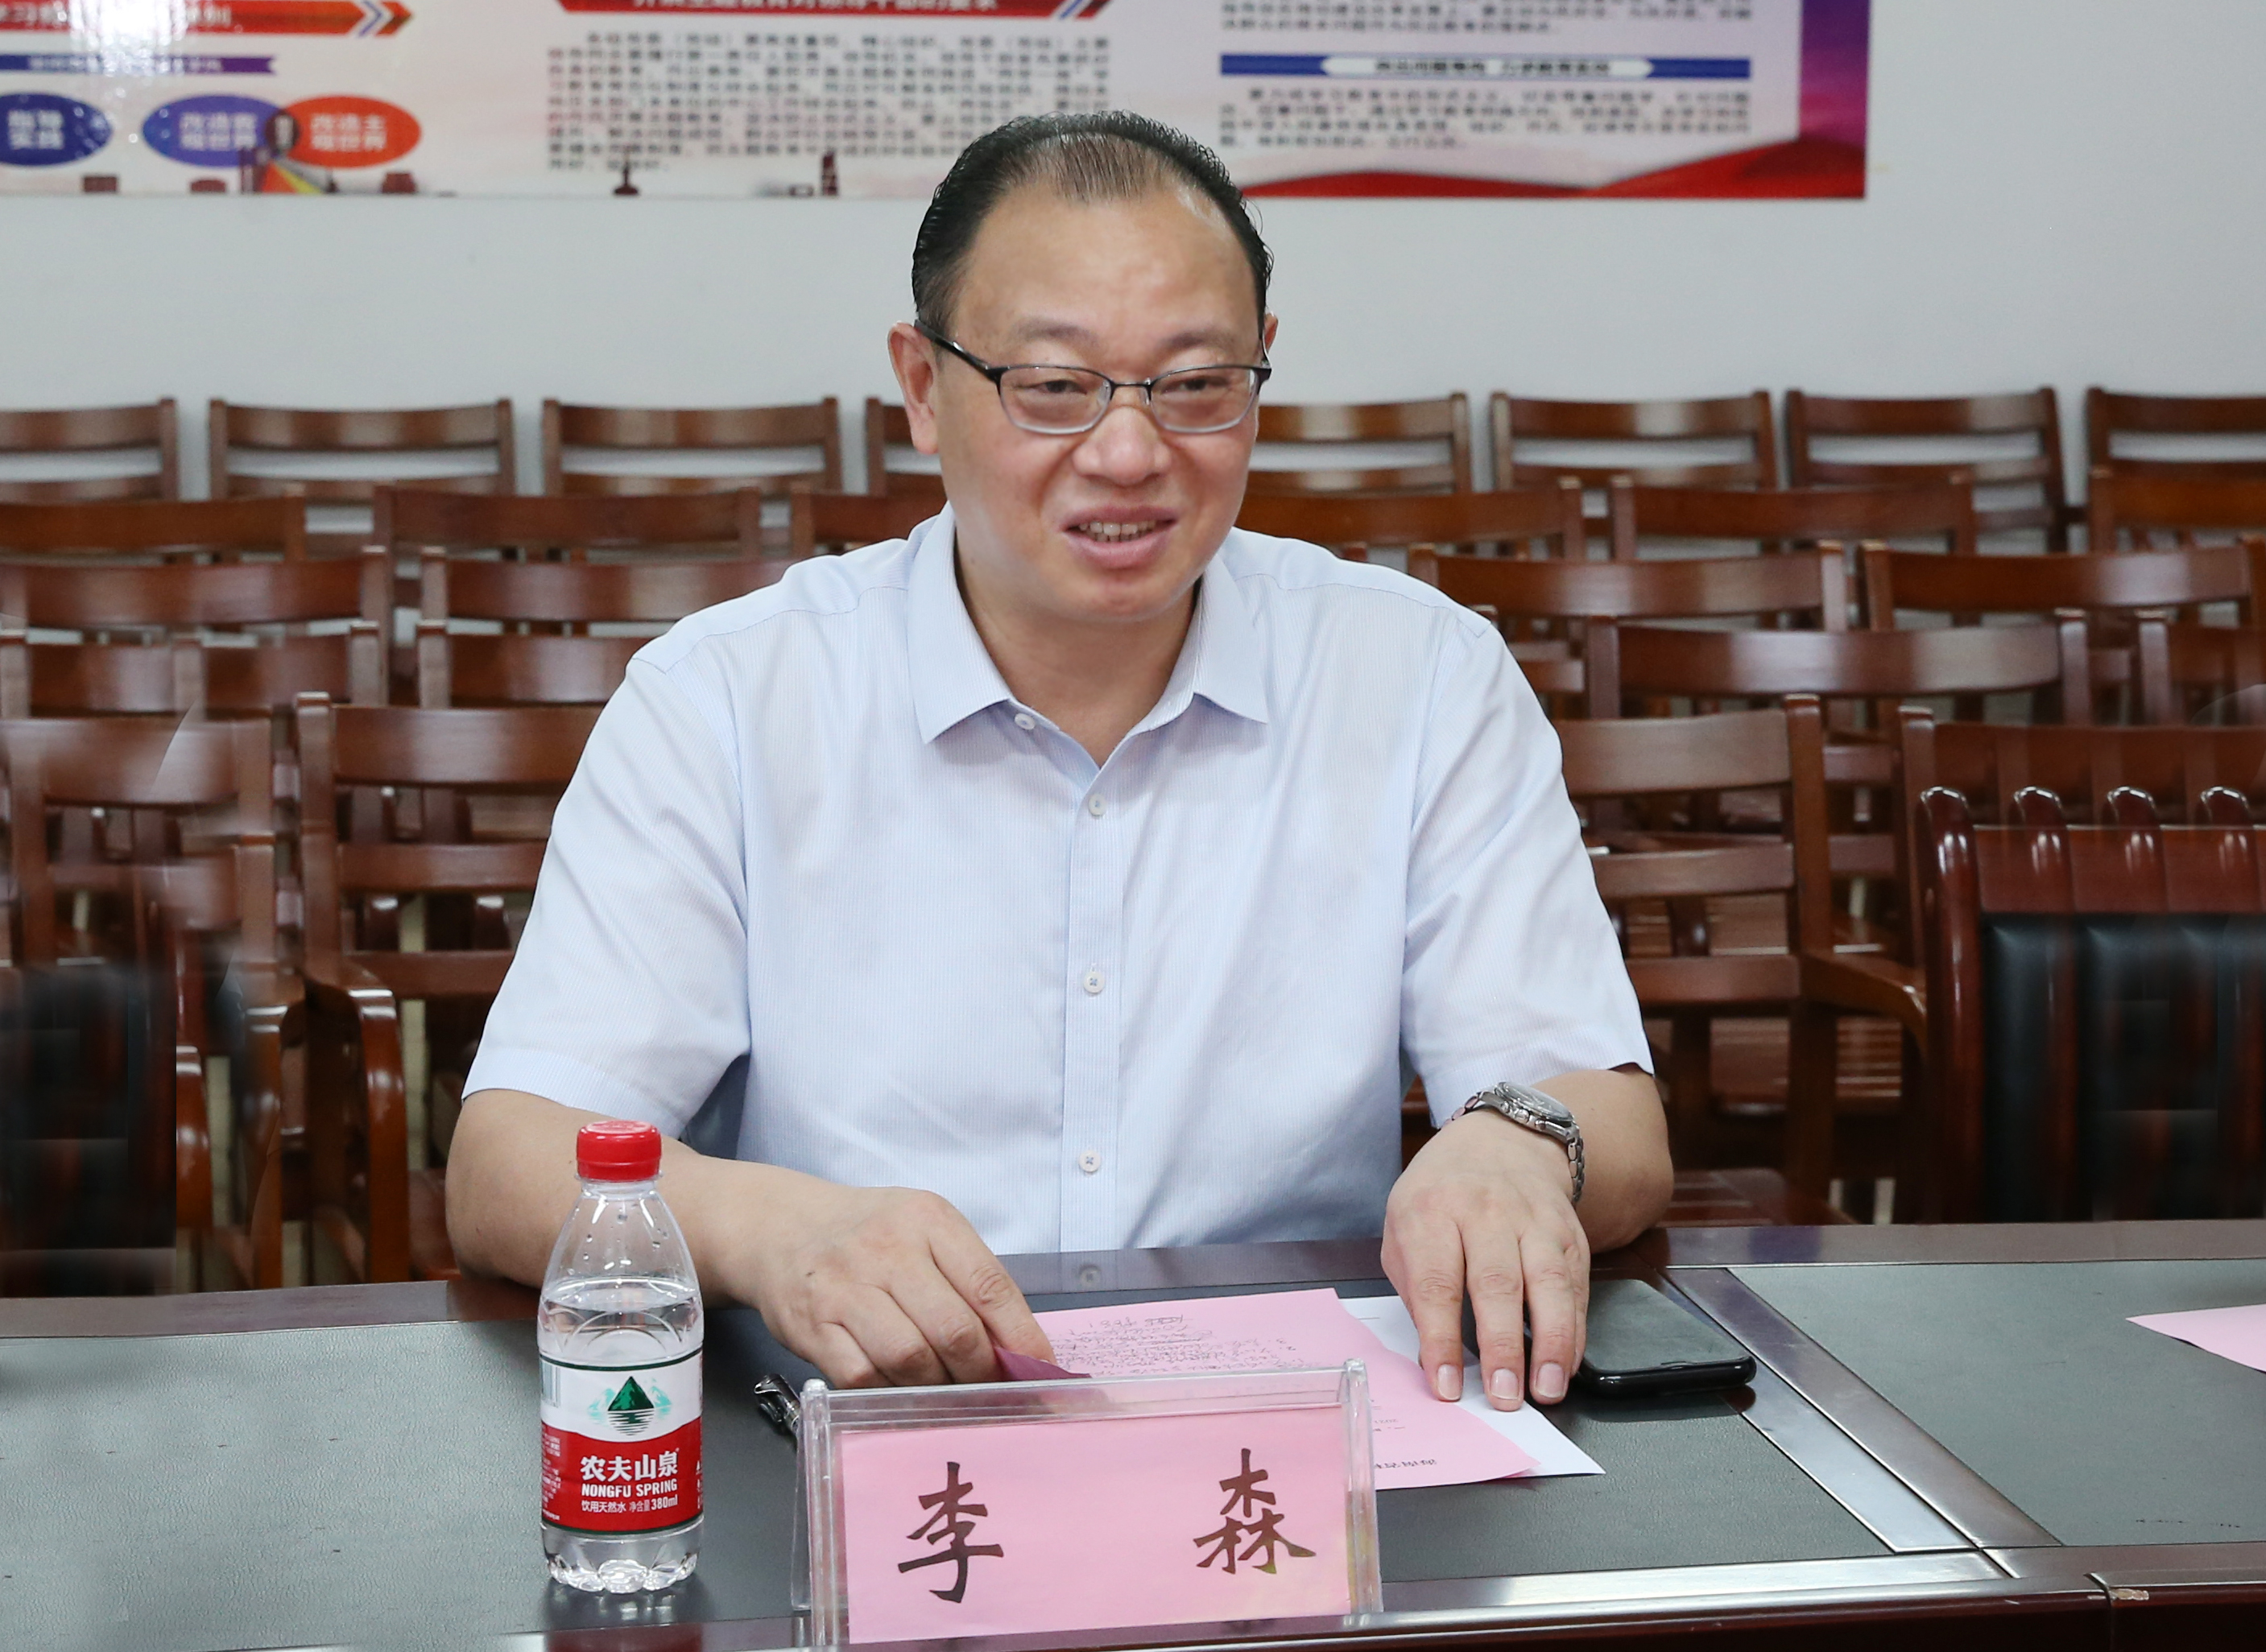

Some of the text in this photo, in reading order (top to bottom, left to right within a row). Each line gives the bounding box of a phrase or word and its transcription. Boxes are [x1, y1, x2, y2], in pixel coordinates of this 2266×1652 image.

[580, 1451, 678, 1482] 农夫山泉
[581, 1478, 678, 1497] NONGFU SPRING
[581, 1500, 626, 1514] 饮用天然水
[898, 1448, 1317, 1603] 李 森
